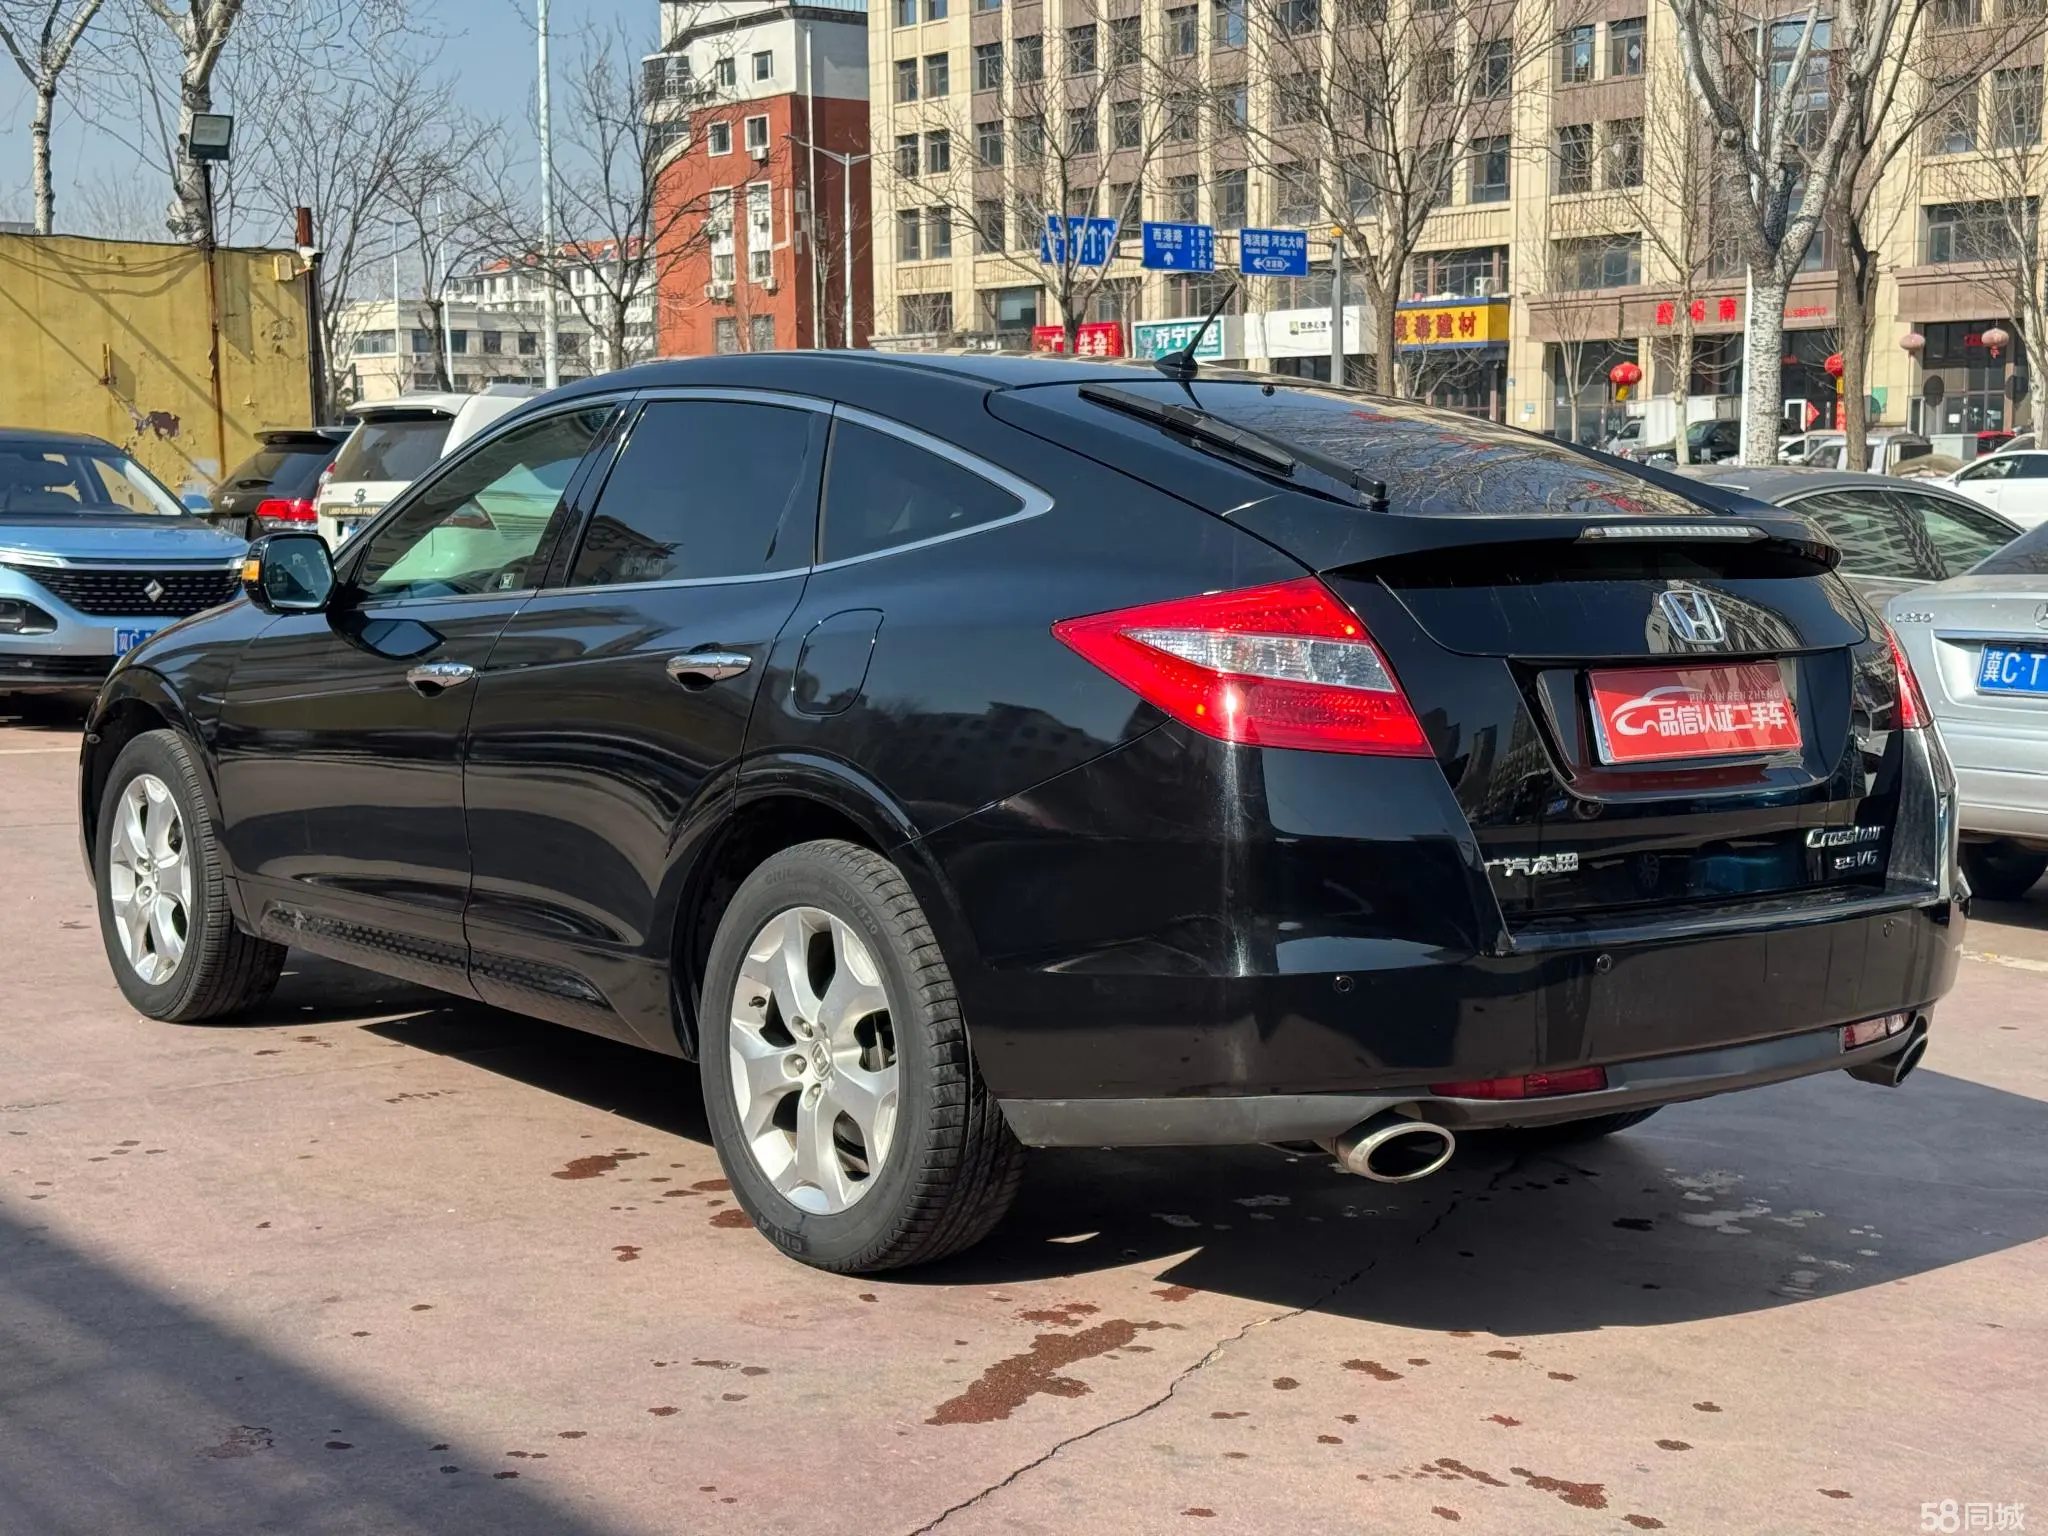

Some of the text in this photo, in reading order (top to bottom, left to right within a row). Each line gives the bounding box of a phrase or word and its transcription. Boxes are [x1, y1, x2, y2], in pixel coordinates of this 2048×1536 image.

[1152, 227, 1183, 243] 西港路
[1271, 234, 1305, 250] 河北大街
[1198, 228, 1207, 269] 和平大街
[1657, 700, 1789, 738] 品信认证二手车
[1806, 825, 1885, 849] Crosstour
[1483, 852, 1579, 877] 广汽本田
